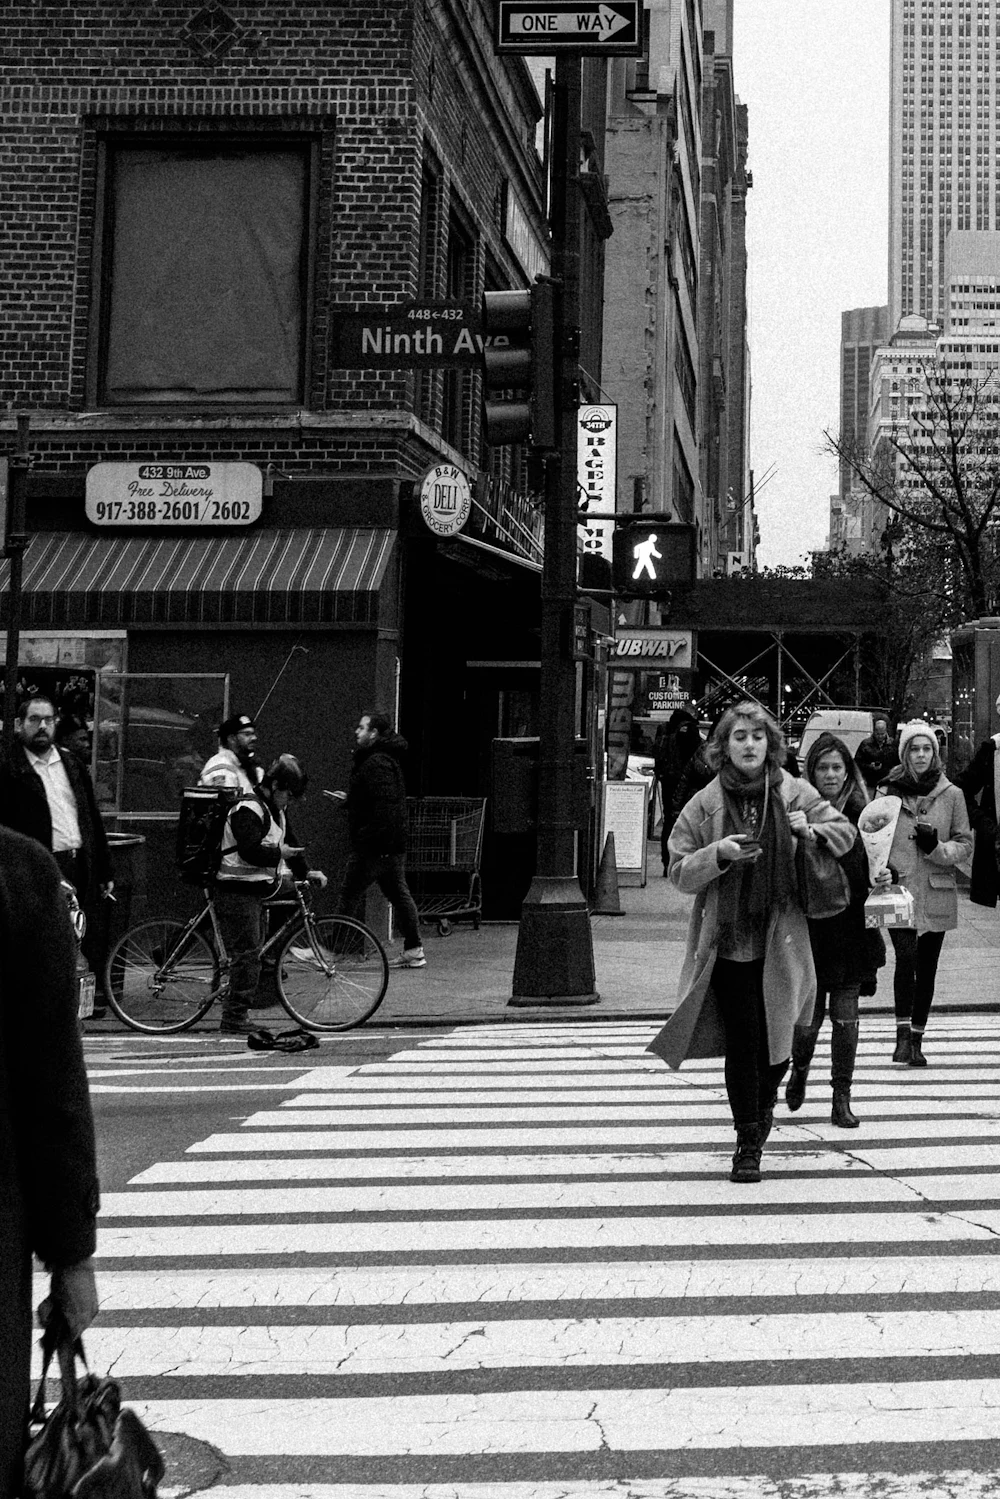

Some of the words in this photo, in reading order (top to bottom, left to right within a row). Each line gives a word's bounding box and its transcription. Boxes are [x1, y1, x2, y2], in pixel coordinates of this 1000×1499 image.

[522, 15, 558, 31] ONE
[577, 14, 617, 31] WAY
[361, 326, 443, 354] Ninth
[452, 327, 510, 354] Ave
[586, 421, 606, 429] 34TH
[141, 467, 163, 478] 432
[166, 467, 183, 478] 9th
[185, 467, 208, 478] Ave.
[584, 437, 606, 501] BAGEL
[127, 481, 154, 497] Free
[158, 481, 214, 500] Delivery
[433, 484, 458, 510] DELI
[423, 505, 453, 533] GROCERY
[612, 637, 688, 657] UBWAY
[652, 700, 686, 710] PARKING
